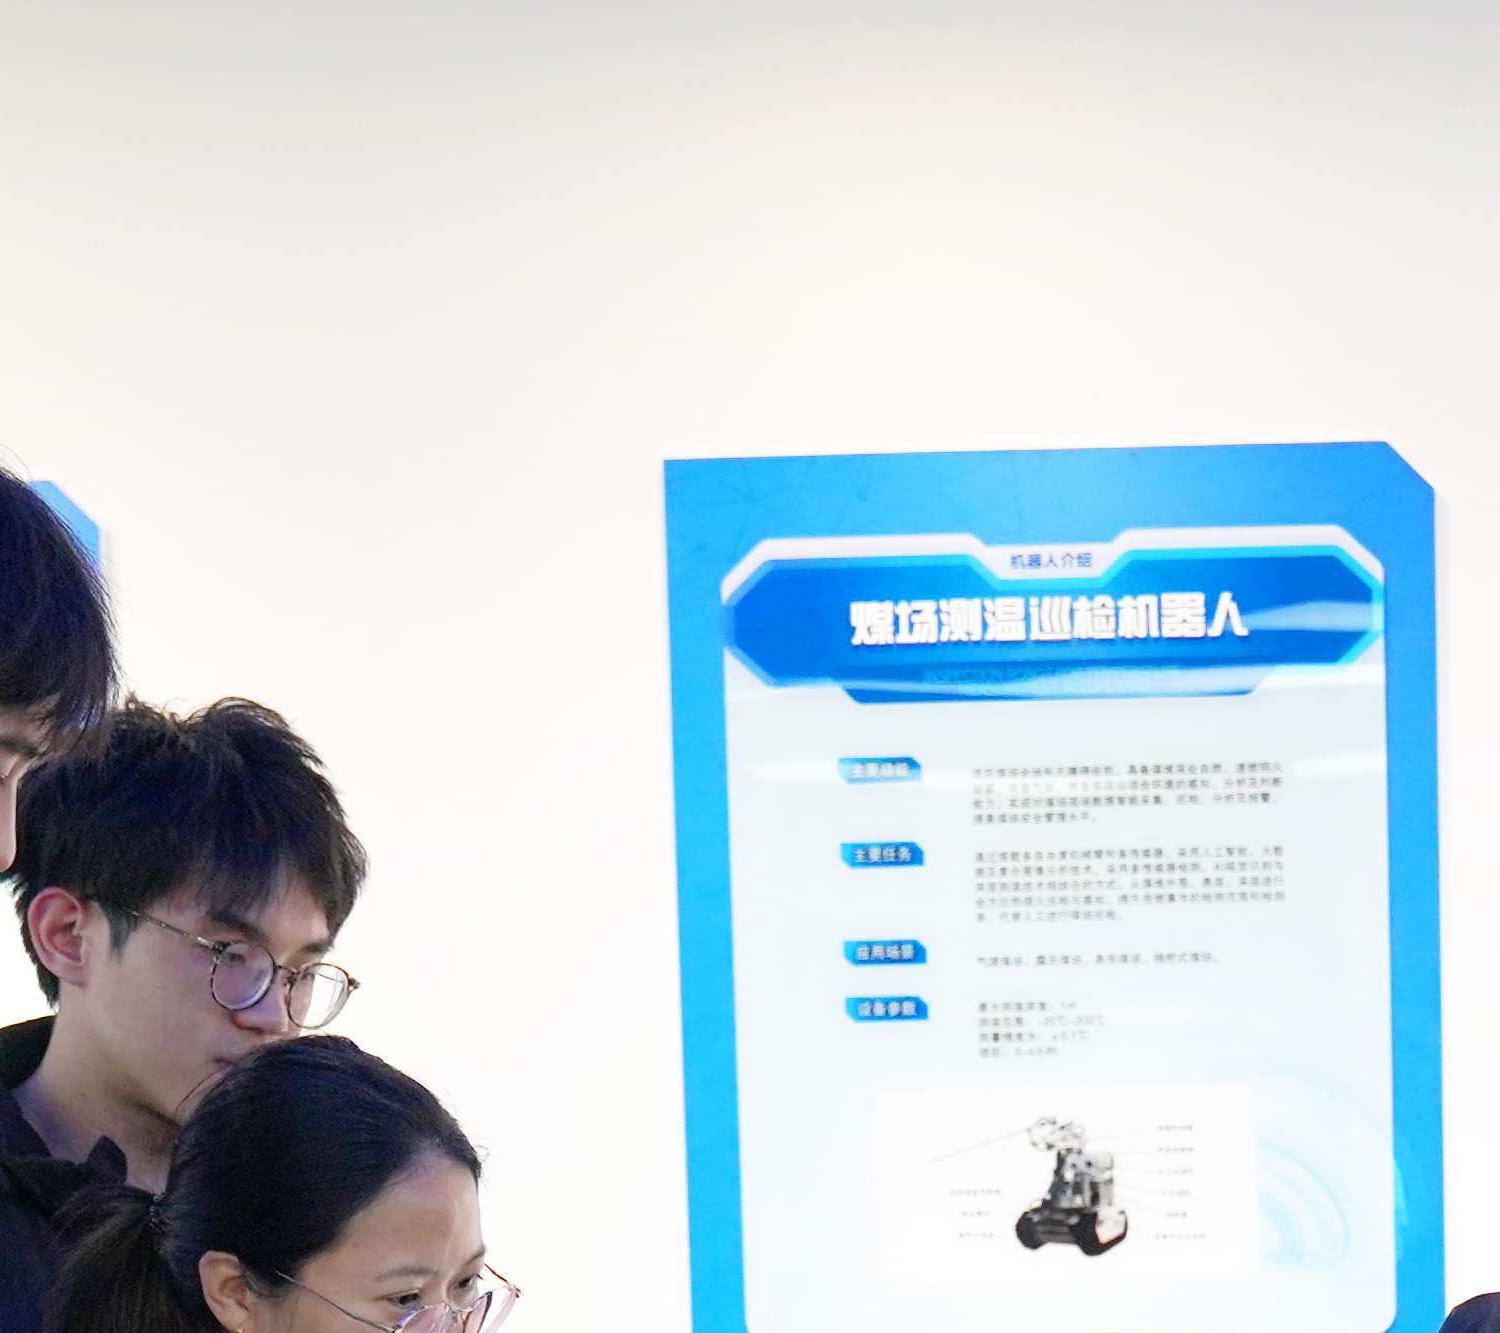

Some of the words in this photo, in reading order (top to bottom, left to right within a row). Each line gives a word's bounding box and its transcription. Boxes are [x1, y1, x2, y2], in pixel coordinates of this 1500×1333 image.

[1010, 550, 1094, 571] 机器人介绍
[851, 591, 1248, 646] 煤场测温巡检机器人
[854, 845, 911, 863] 主要任务
[856, 942, 915, 962] 应用场景
[857, 1000, 917, 1019] 设备参数
